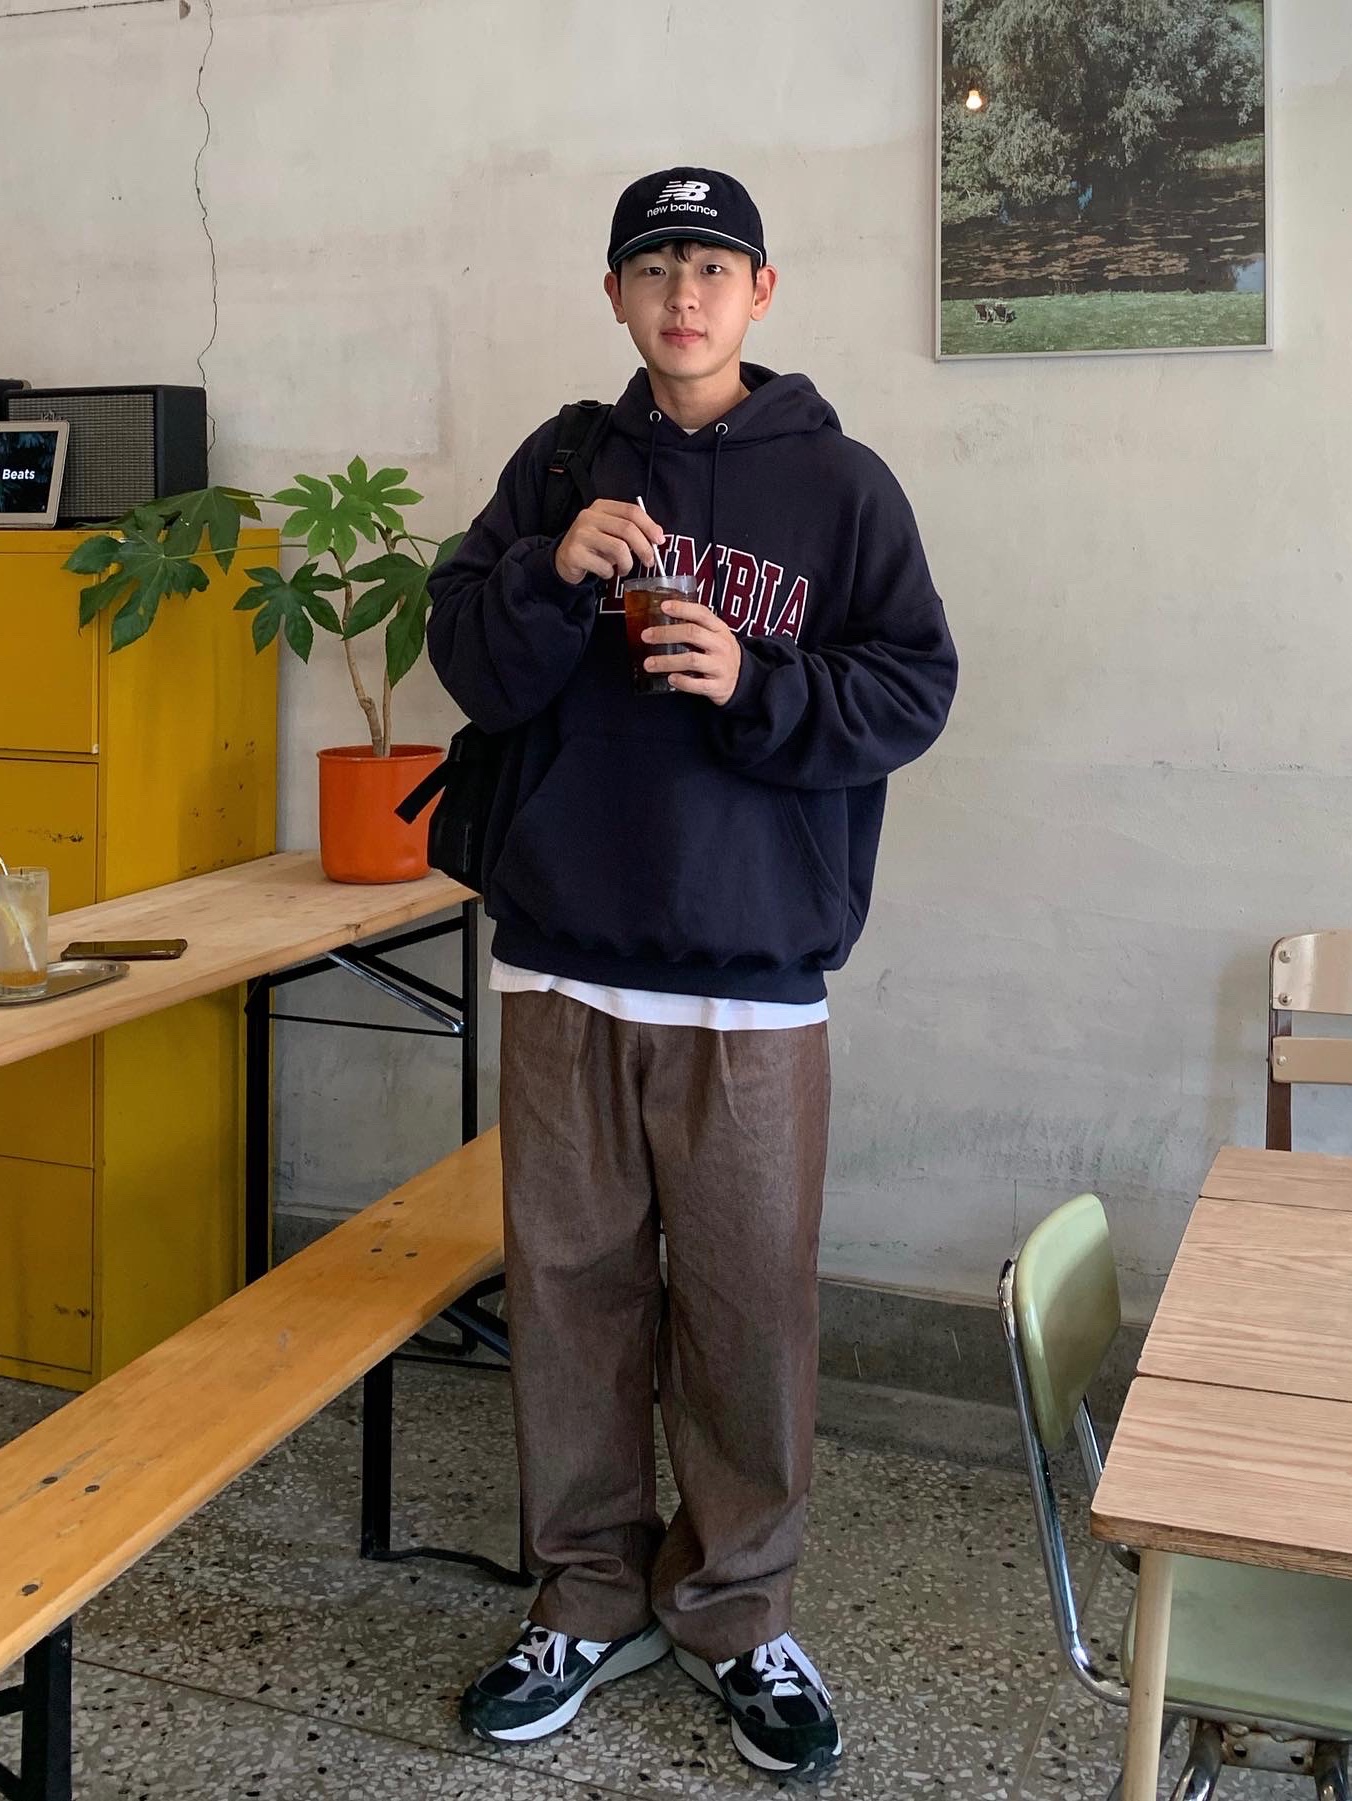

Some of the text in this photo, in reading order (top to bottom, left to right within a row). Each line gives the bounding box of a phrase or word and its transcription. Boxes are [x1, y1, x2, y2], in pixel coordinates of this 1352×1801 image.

[646, 203, 718, 218] new balance
[2, 468, 36, 480] Beats
